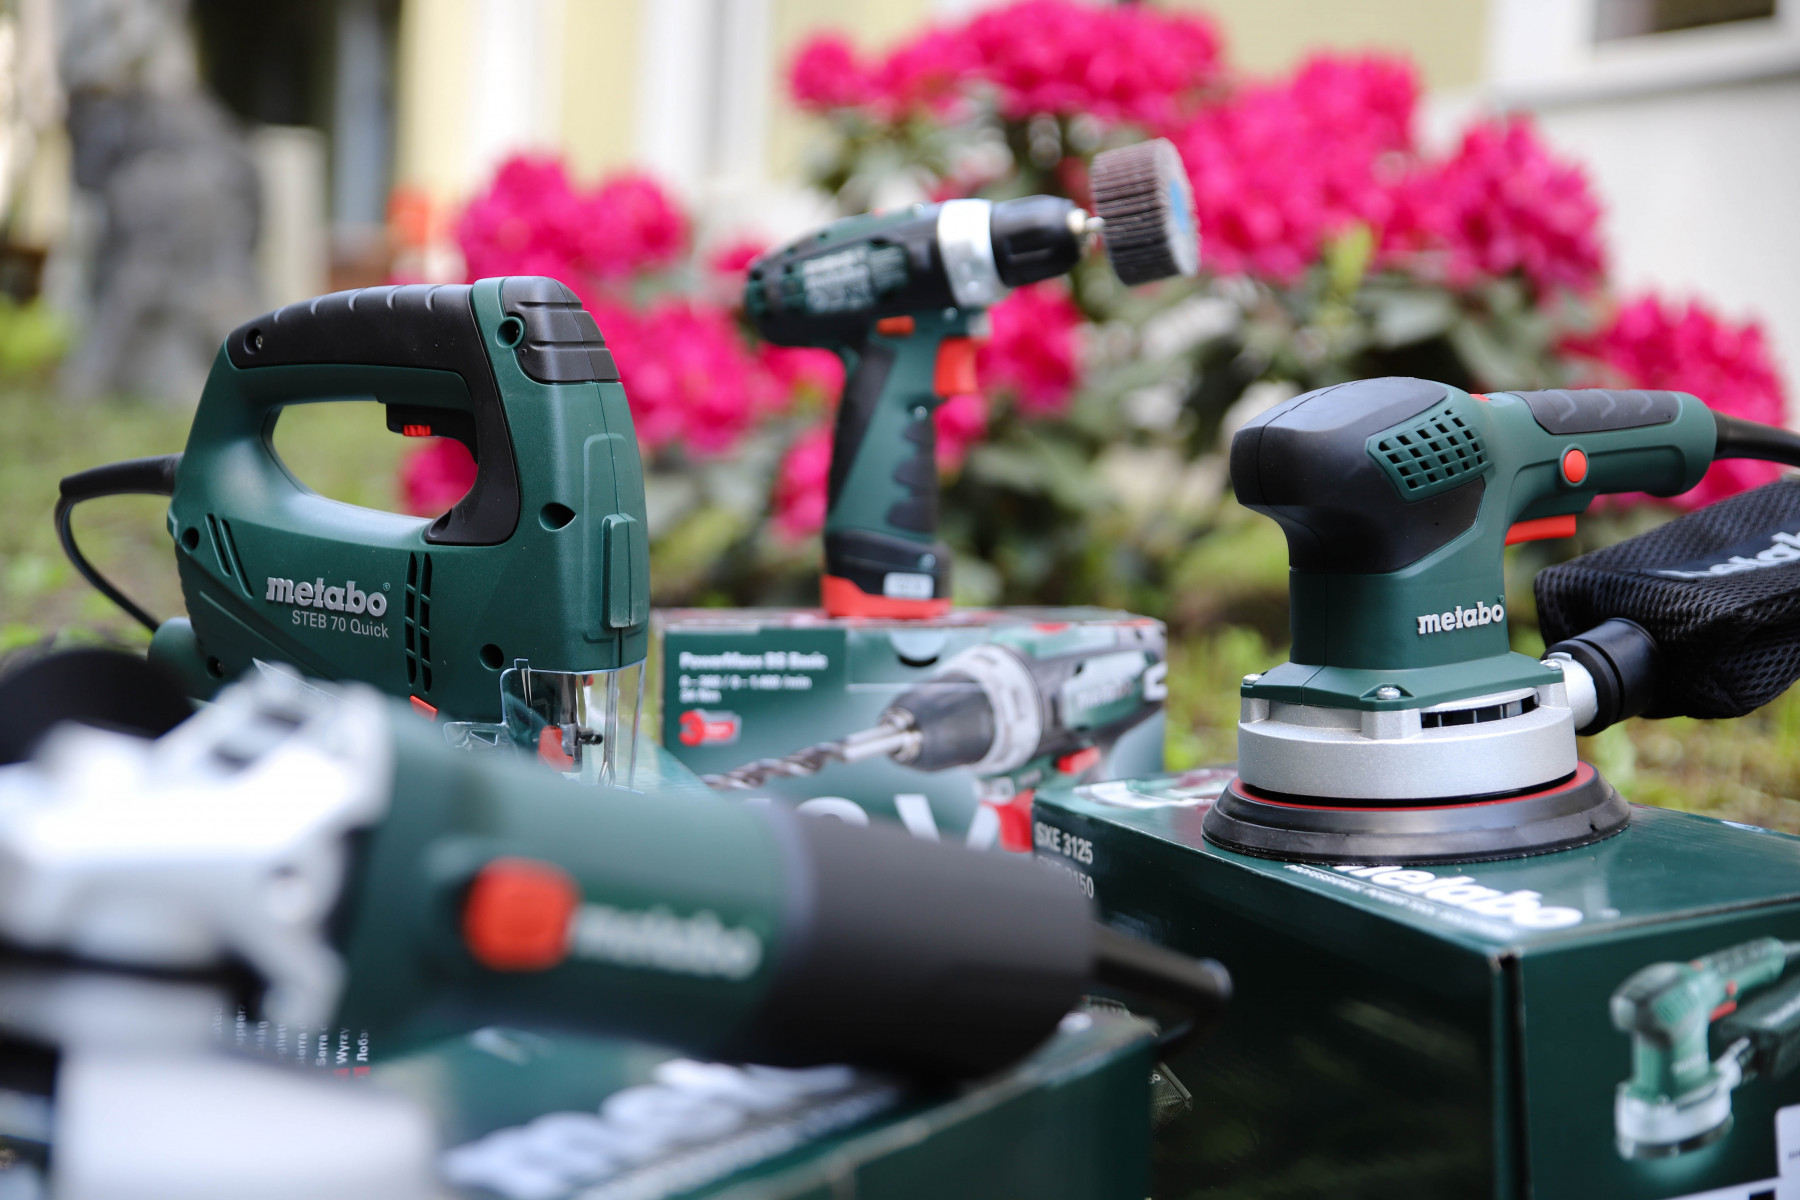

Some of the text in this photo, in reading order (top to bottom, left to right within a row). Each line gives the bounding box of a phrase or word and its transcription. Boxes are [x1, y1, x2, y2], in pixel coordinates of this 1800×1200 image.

[266, 577, 388, 617] metabo
[292, 609, 389, 638] STEB 70 Quick
[1418, 601, 1505, 635] metabo
[679, 710, 704, 746] 3
[1034, 821, 1061, 852] SXE
[1062, 832, 1093, 865] 3125
